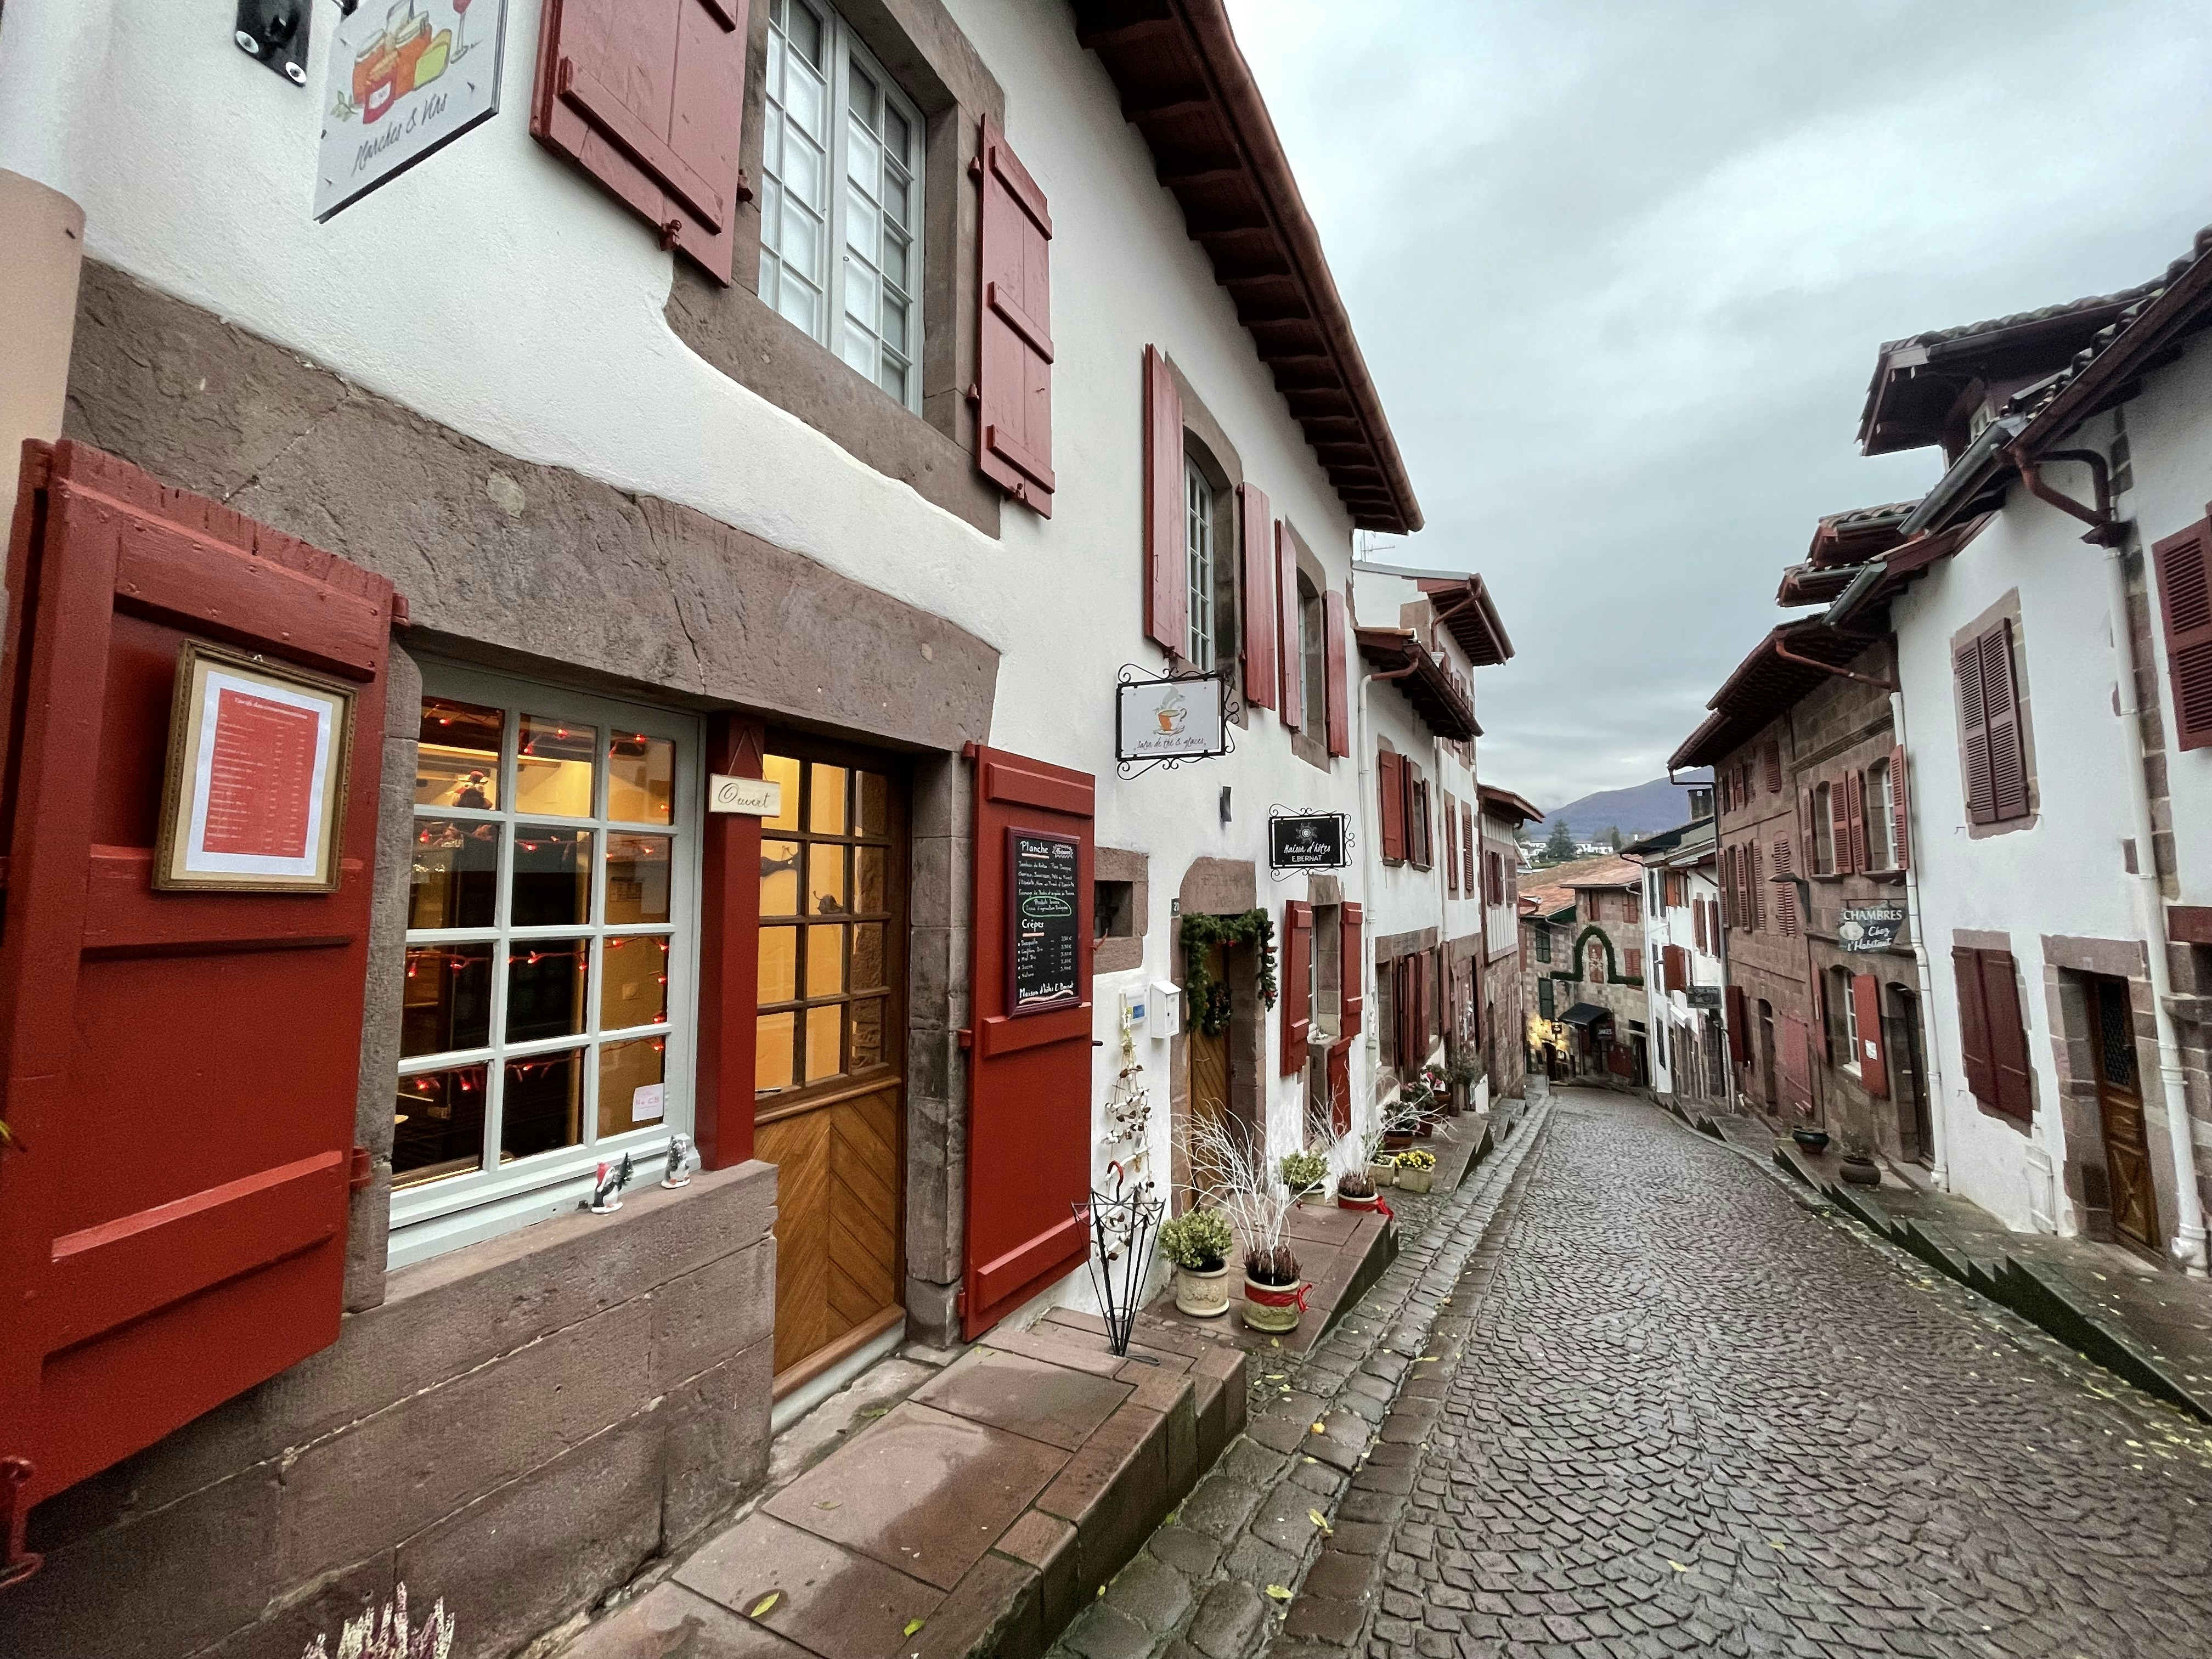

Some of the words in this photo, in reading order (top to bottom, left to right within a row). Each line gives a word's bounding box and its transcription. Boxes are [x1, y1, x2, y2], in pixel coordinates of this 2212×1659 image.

[406, 107, 418, 134] &
[1154, 737, 1162, 748] de
[1175, 737, 1181, 746] &
[1183, 736, 1205, 749] glaces
[718, 782, 770, 808] Ouvert
[1020, 840, 1049, 854] Planche
[1283, 844, 1306, 854] Maison
[1843, 910, 1903, 921] CHAMBRES
[1022, 918, 1044, 933] Crêpes
[1868, 926, 1891, 937] Chez
[1847, 938, 1893, 952] l'Habitant
